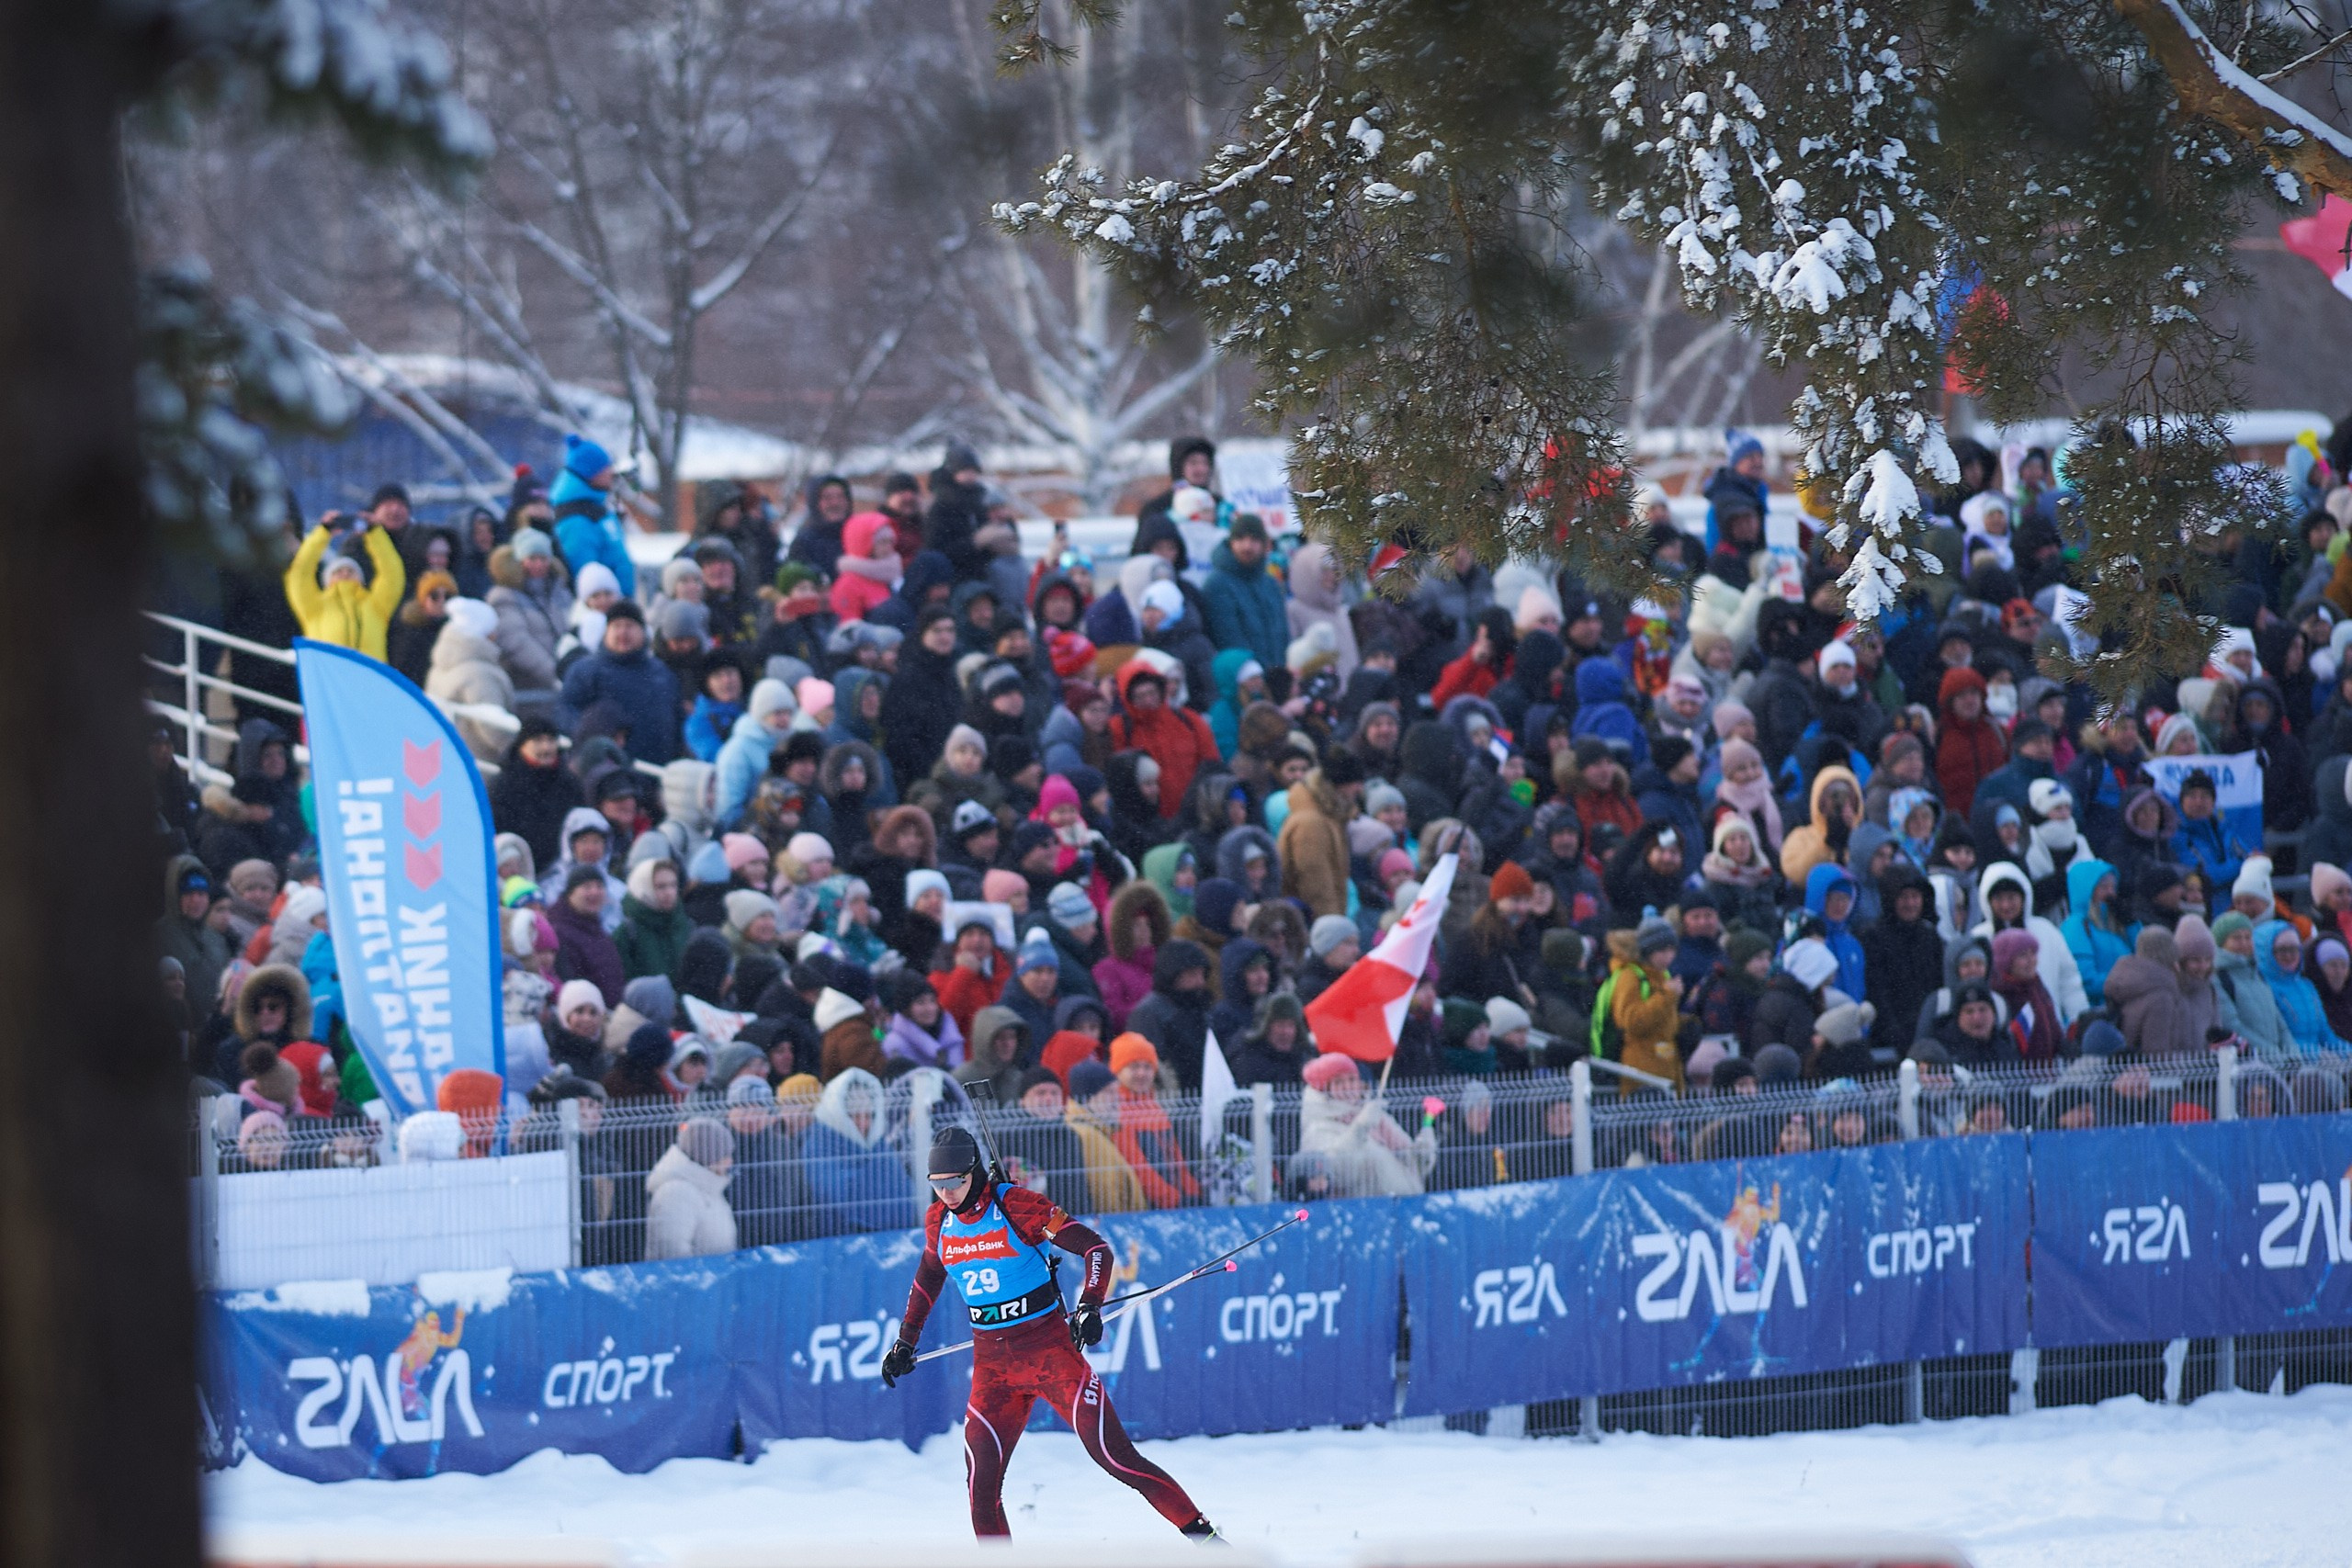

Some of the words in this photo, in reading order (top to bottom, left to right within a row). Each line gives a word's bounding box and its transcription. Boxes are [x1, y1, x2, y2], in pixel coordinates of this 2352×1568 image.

[944, 1244, 977, 1258] Альфа
[978, 1240, 1005, 1252] Банк
[1868, 1223, 1975, 1278] СПОРТ
[962, 1268, 1001, 1296] 29
[969, 1297, 1027, 1321] PARI
[1221, 1290, 1341, 1343] СПОРТ
[544, 1353, 674, 1408] СПОРТ
